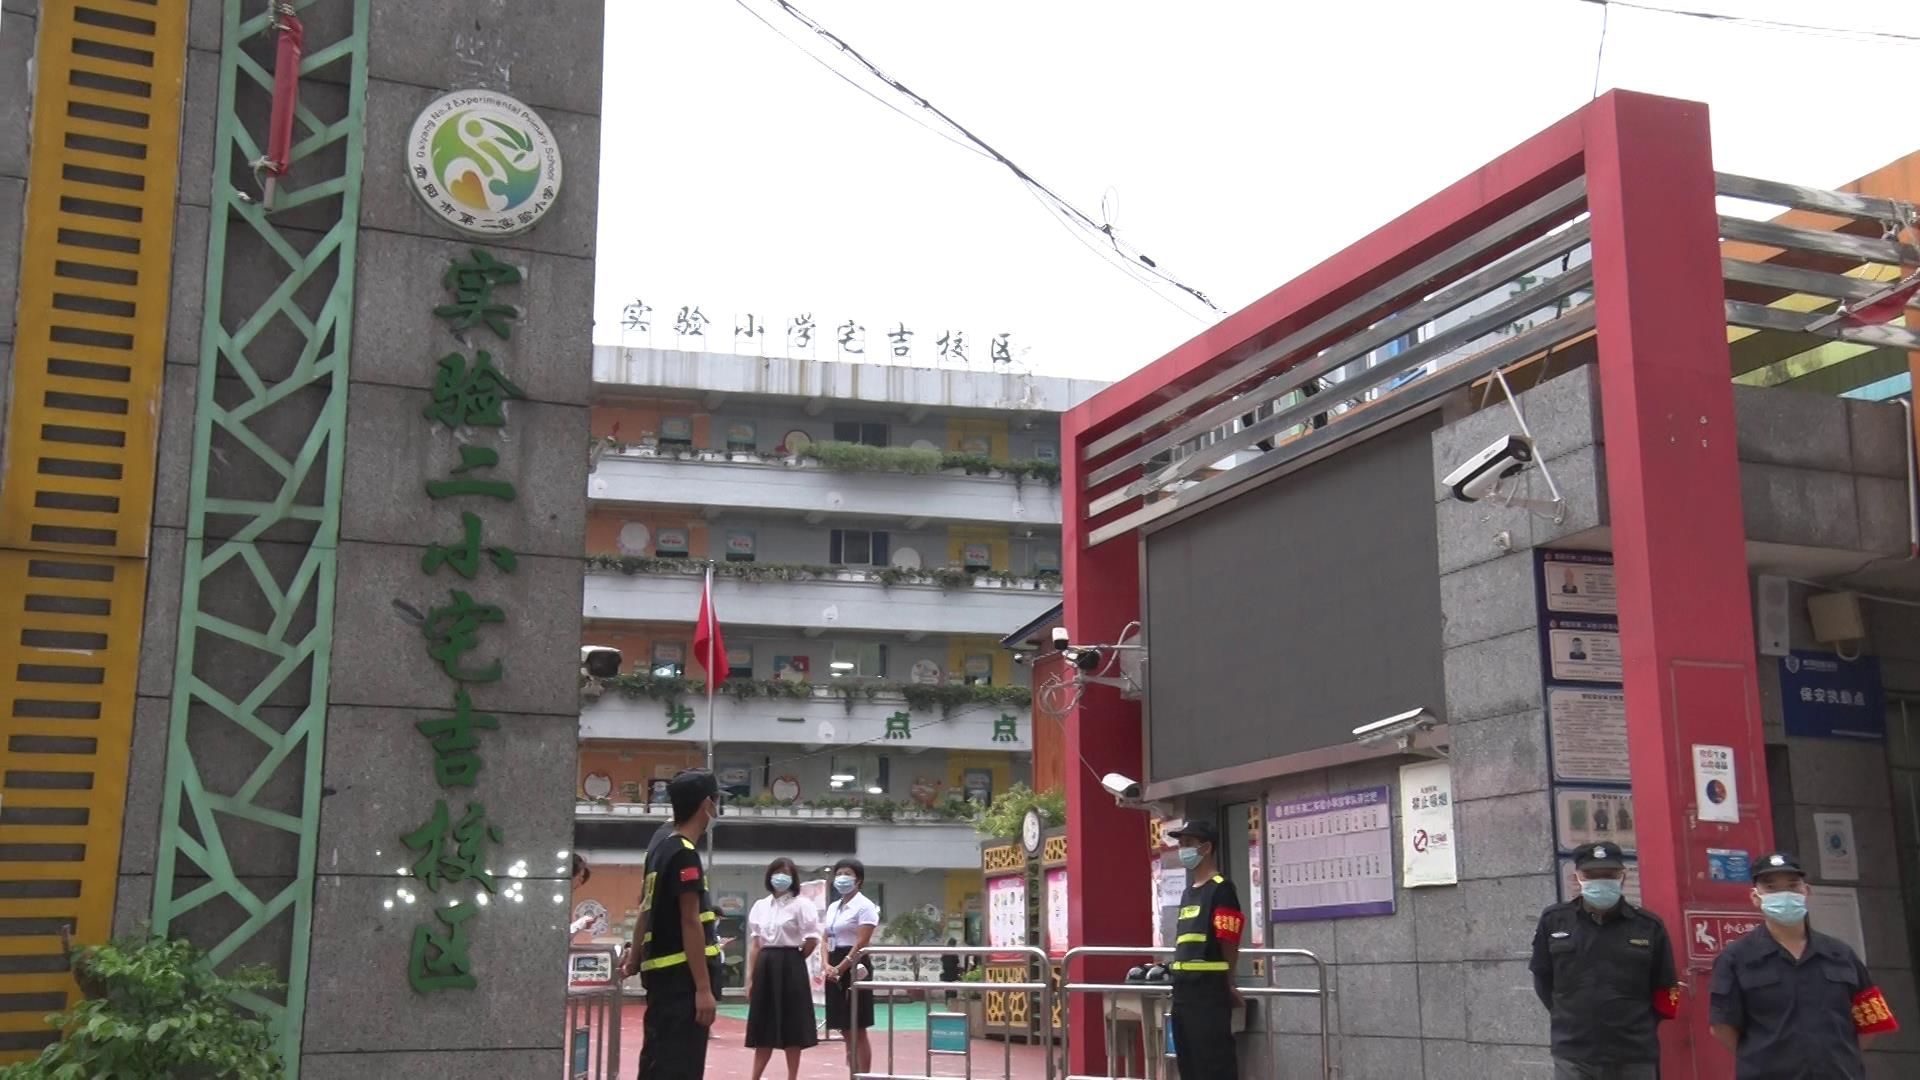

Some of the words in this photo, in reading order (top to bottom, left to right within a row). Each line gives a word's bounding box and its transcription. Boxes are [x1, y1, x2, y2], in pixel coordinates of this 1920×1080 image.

[452, 97, 521, 115] Experimental
[521, 111, 547, 144] Primary
[545, 147, 555, 182] School
[620, 299, 1012, 364] 实验小学宅吉校区
[400, 249, 527, 993] 实验二小宅吉校区
[1412, 792, 1448, 811] 禁止吸烟
[1724, 921, 1761, 934] 小心地
